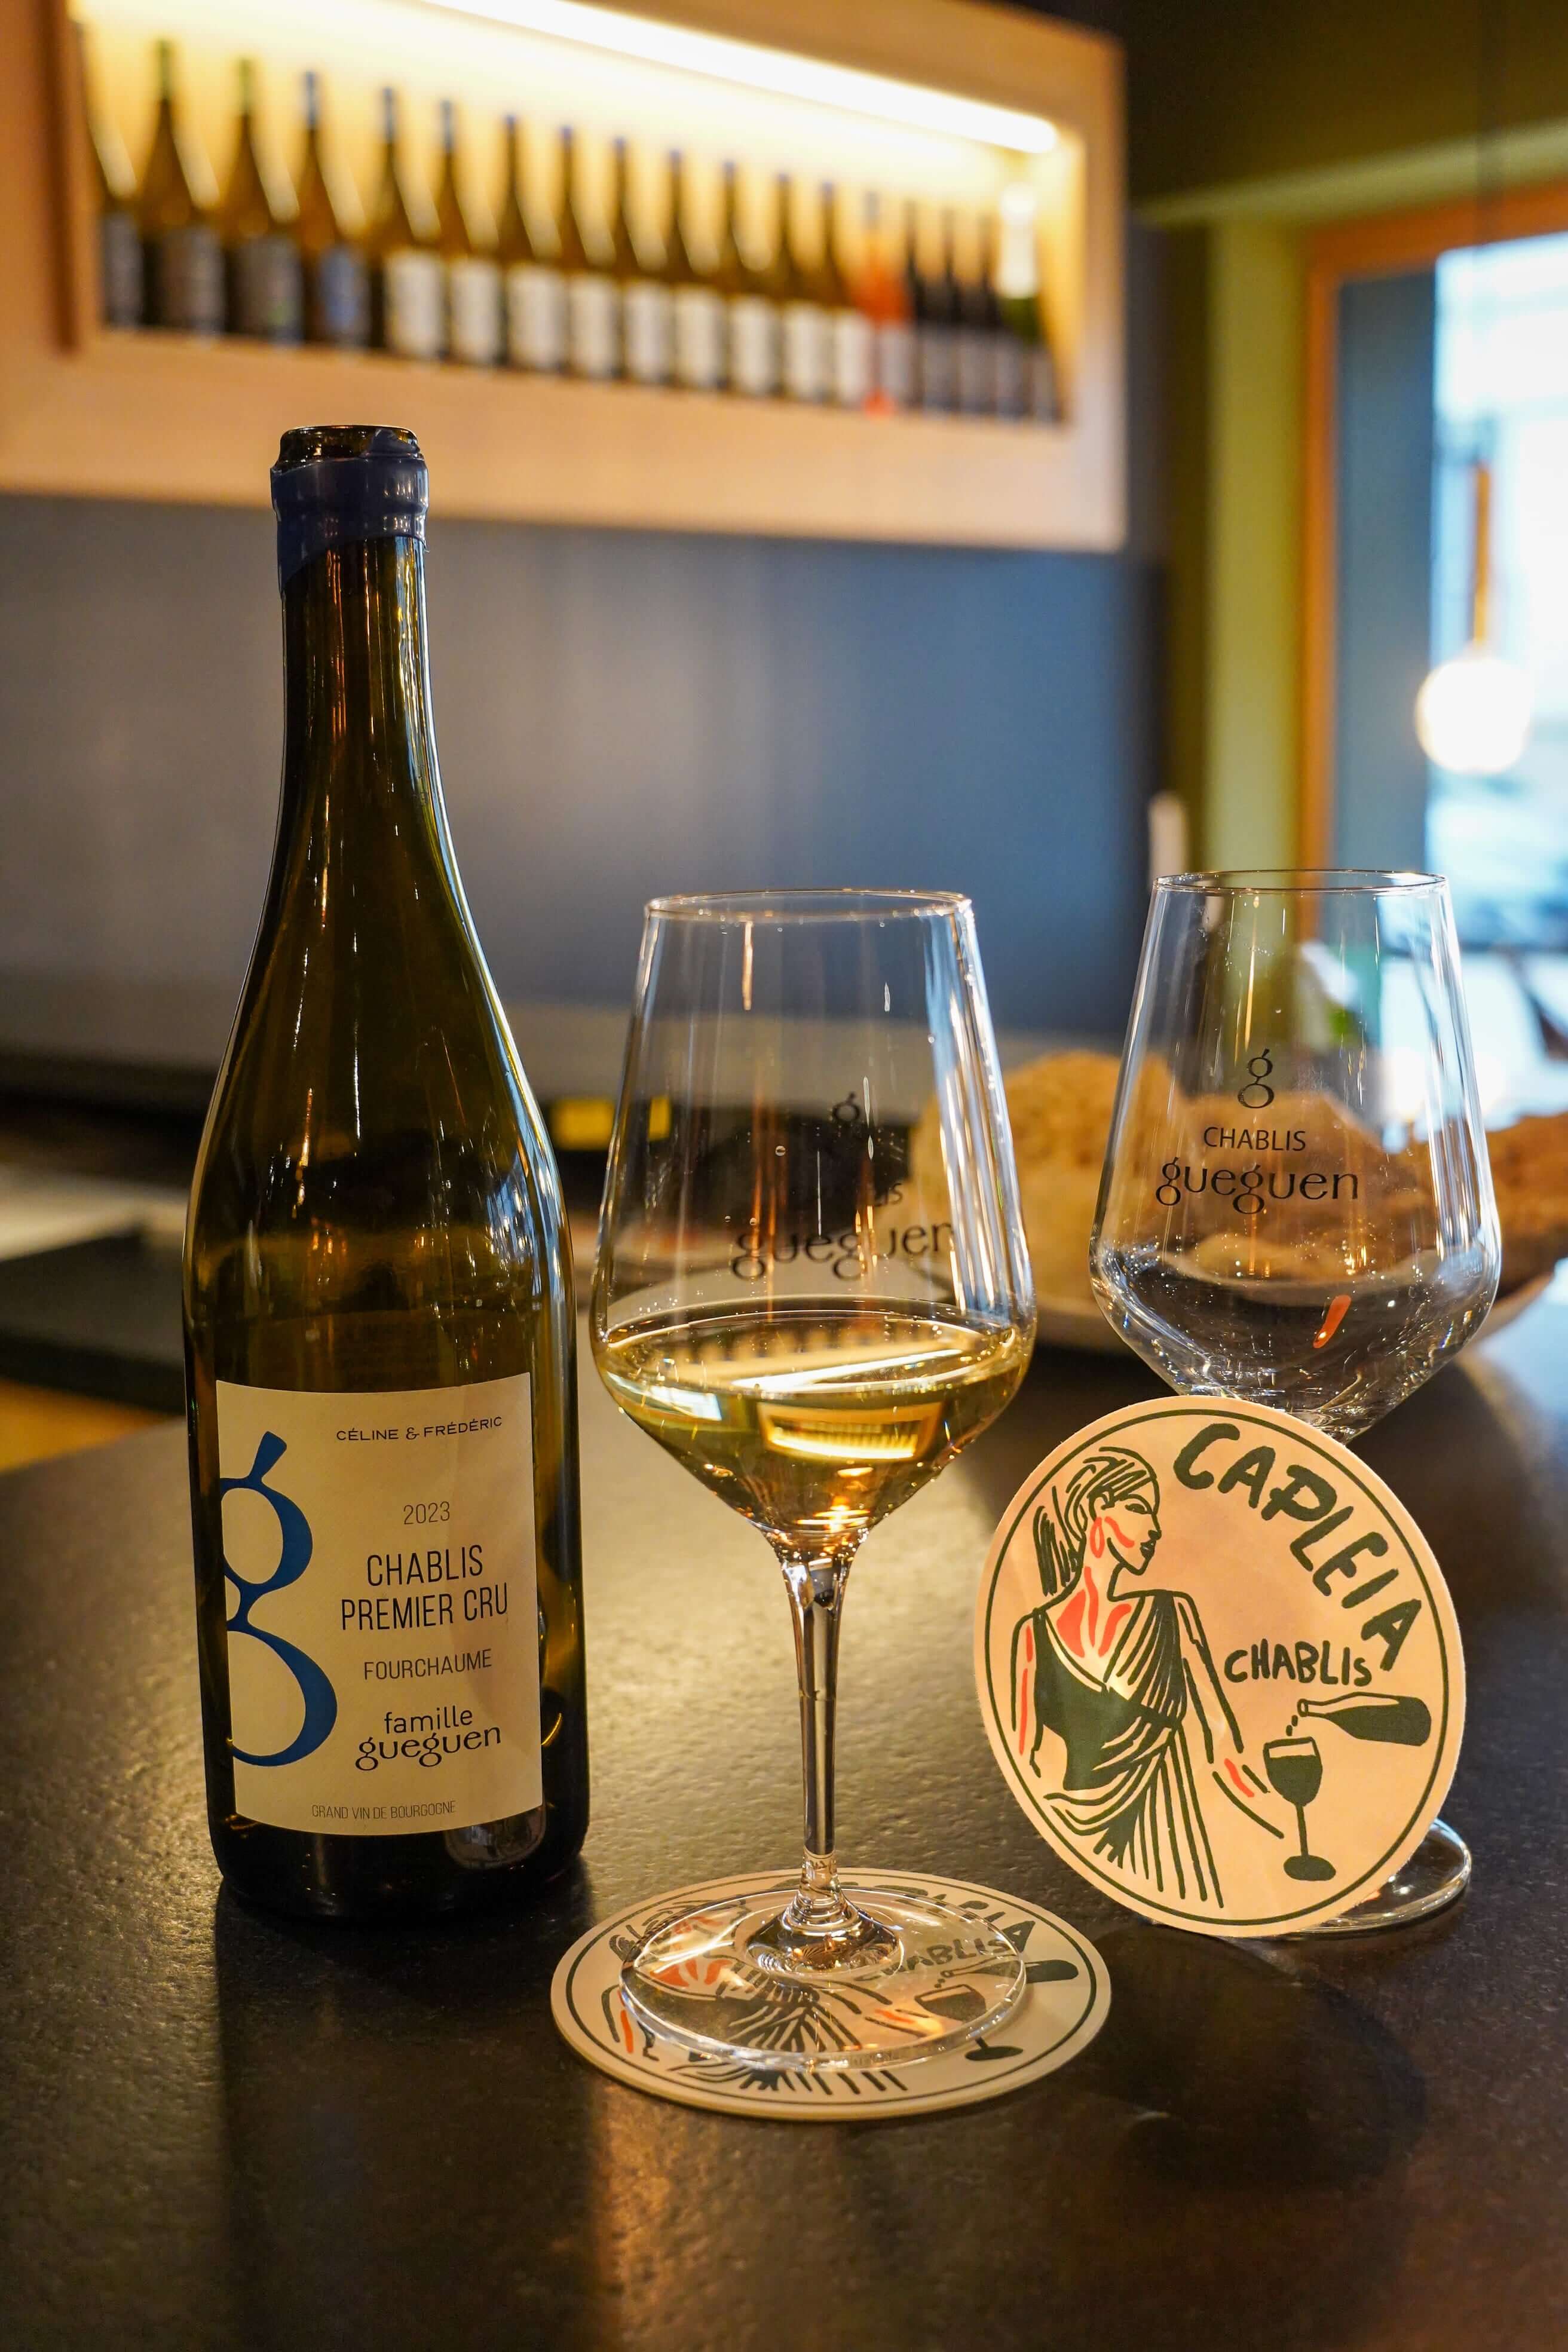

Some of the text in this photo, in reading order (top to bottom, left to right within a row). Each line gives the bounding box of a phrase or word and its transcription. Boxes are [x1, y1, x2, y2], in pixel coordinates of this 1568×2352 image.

[1203, 1126, 1307, 1152] CHABLIS
[1155, 1156, 1359, 1215] gueguen
[336, 1416, 503, 1441] CÉLINE & FRÉDÉRIC
[403, 1500, 451, 1525] 2023
[366, 1544, 483, 1587] CHABLIS
[1173, 1422, 1422, 1671] CAPLEIA
[341, 1581, 508, 1631] PREMIER CRU
[363, 1647, 492, 1680] FOURCHAUME
[1223, 1638, 1373, 1687] CHABLIS
[384, 1705, 473, 1734] famille
[354, 1726, 501, 1771] gueguen
[311, 1799, 457, 1820] GRAND VIN DE BOURGOGNE
